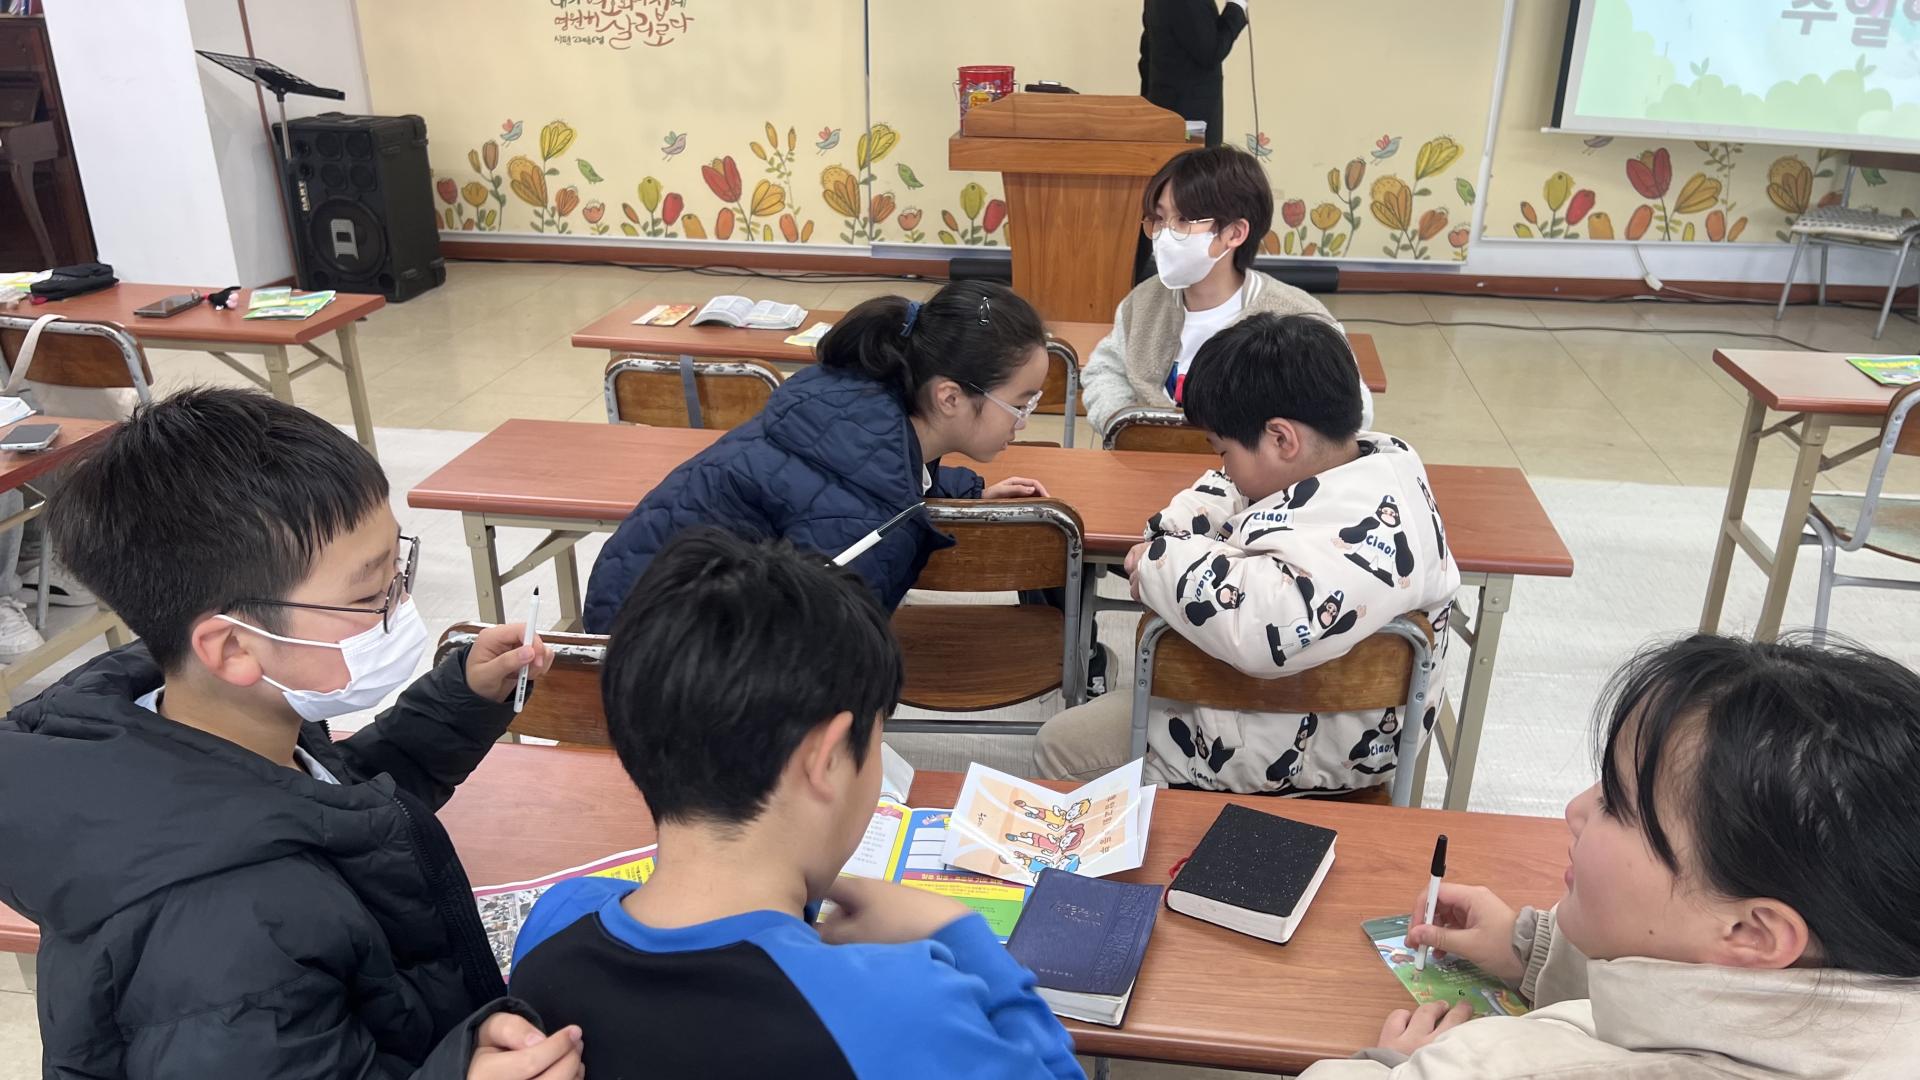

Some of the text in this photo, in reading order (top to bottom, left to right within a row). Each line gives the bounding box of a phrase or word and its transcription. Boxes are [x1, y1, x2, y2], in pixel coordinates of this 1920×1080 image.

[554, 9, 695, 50] 영원히 살리로다
[1253, 511, 1288, 523] Ciao!
[1366, 534, 1397, 558] Ciao!
[1194, 569, 1213, 601] Ciao!
